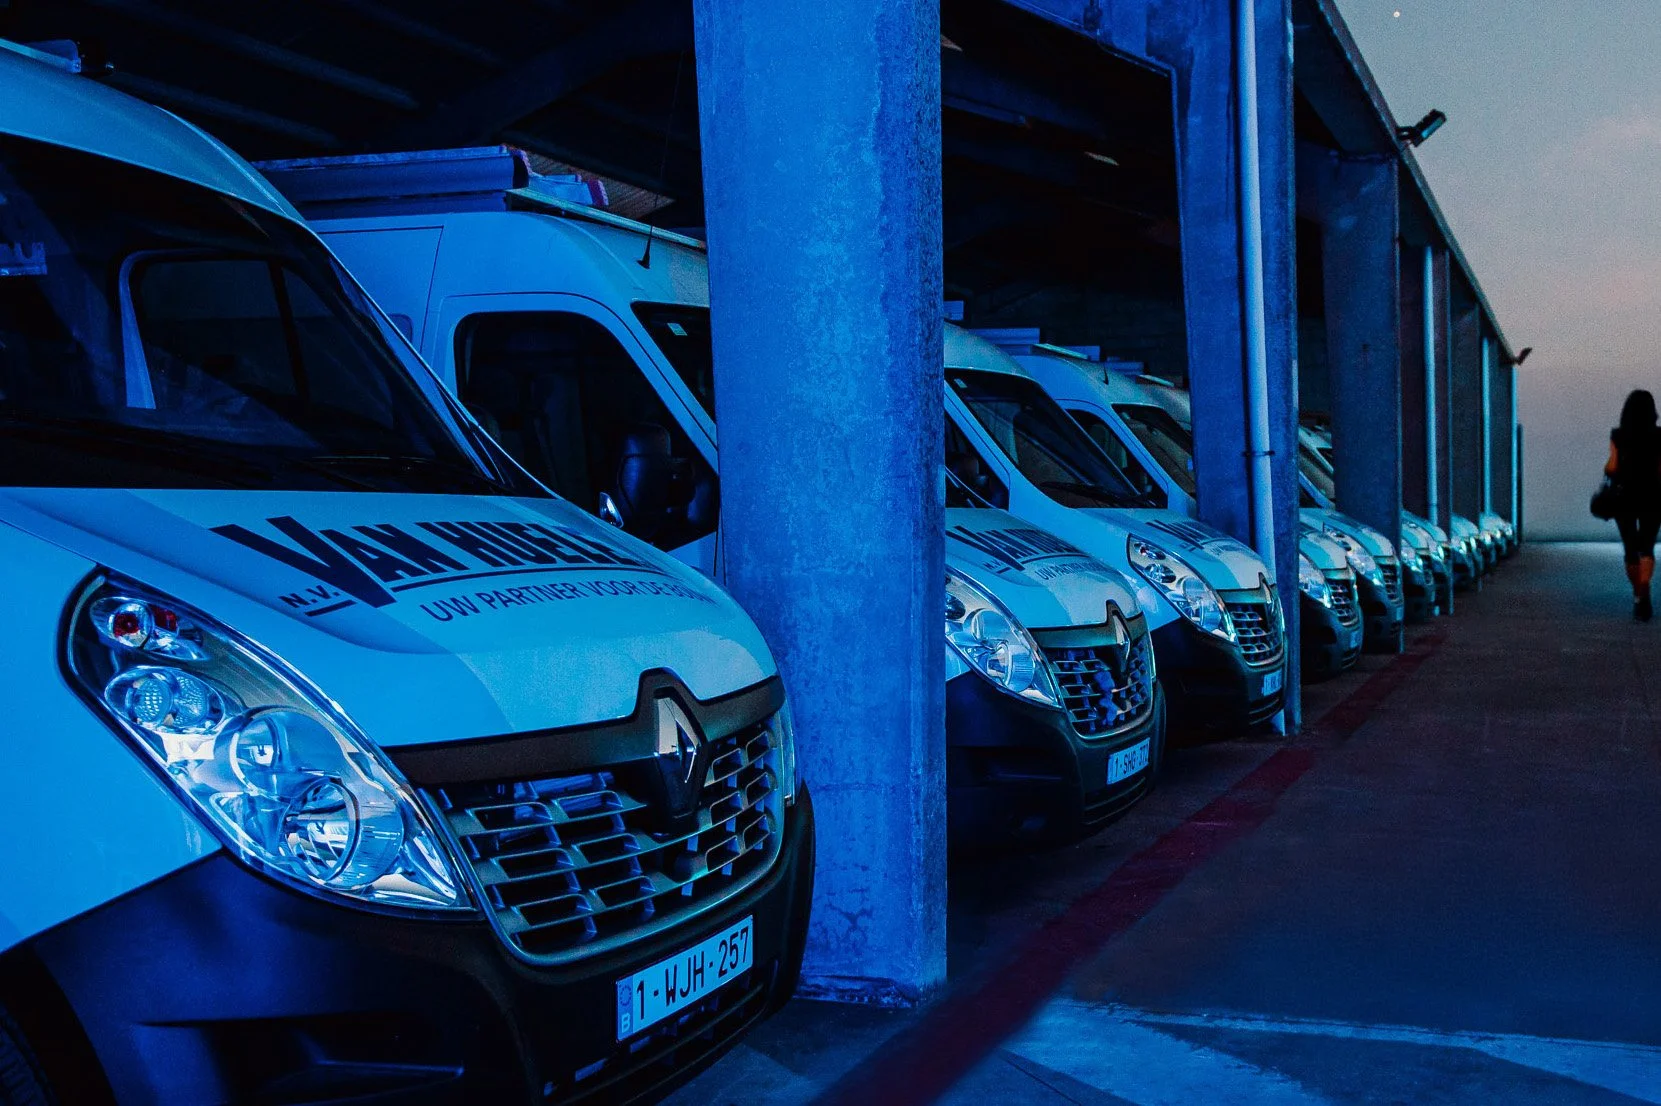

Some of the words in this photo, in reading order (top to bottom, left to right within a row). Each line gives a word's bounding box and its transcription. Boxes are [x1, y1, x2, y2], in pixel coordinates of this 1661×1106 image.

[209, 515, 470, 608] VAN
[277, 584, 341, 609] N.V.
[419, 594, 480, 621] UW
[475, 582, 584, 609] PARTNER
[578, 580, 647, 597] VOOR
[637, 581, 672, 596] DE
[636, 926, 749, 1020] 1-WJH-257
[621, 1012, 631, 1033] B
